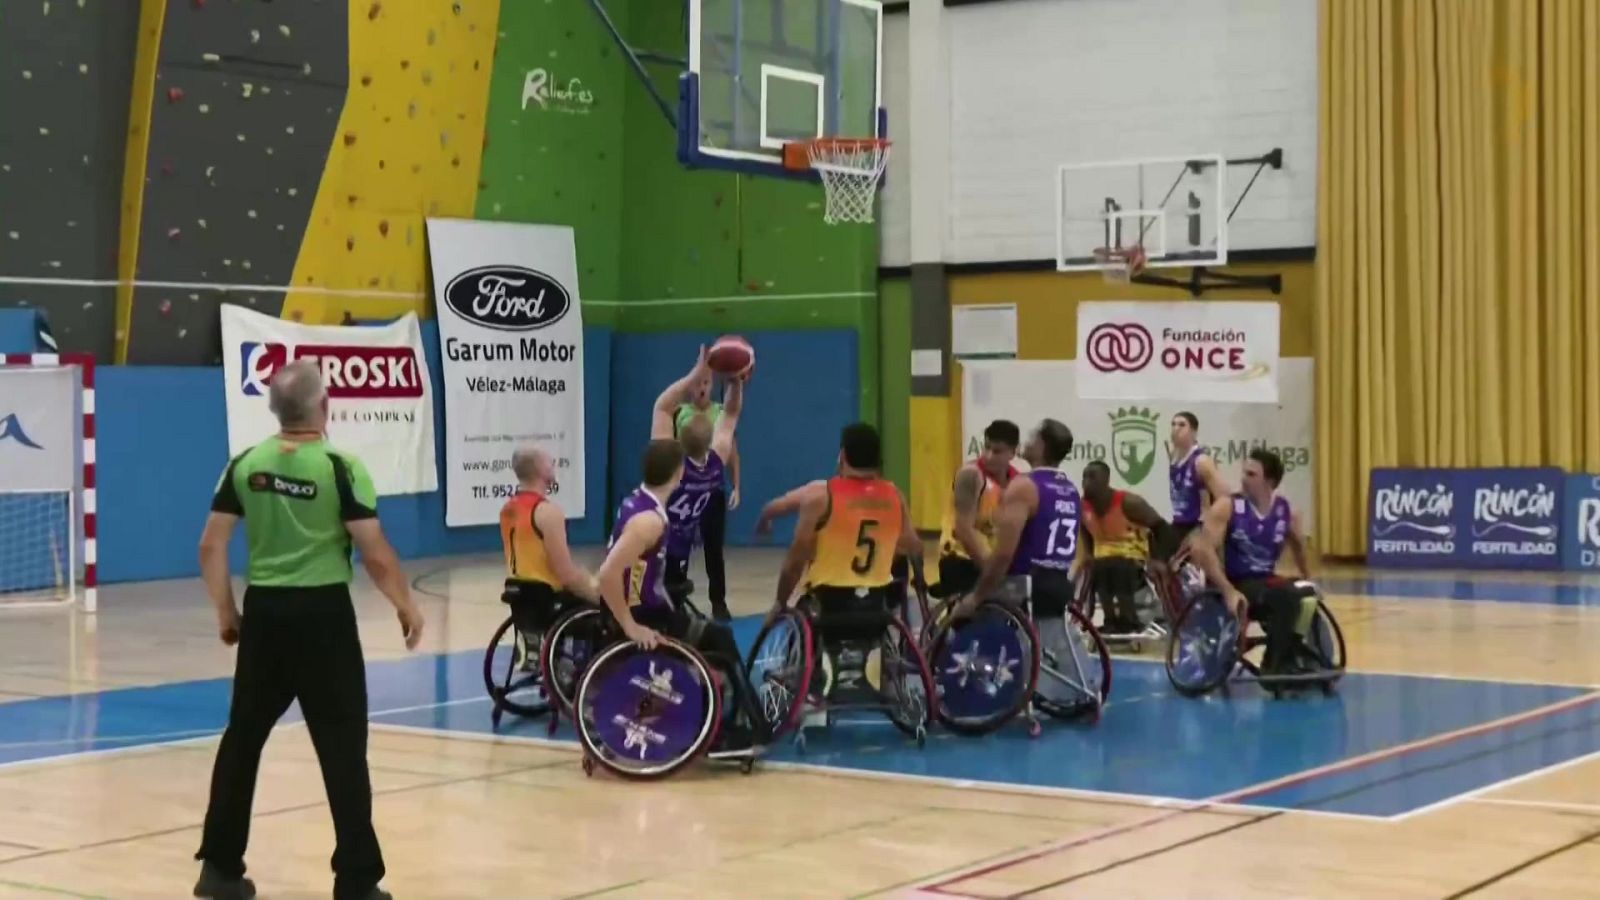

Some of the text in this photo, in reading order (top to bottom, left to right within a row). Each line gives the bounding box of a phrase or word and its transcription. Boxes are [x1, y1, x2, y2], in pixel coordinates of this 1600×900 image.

[472, 275, 545, 319] Ford
[1163, 327, 1245, 342] Fundación
[446, 337, 576, 362] Garum Motor
[1161, 347, 1246, 370] ONCE
[466, 376, 566, 395] Vélez-Málaga
[669, 492, 711, 520] 40
[851, 519, 879, 576] 5
[1046, 518, 1077, 555] 13
[1374, 540, 1455, 553] FERTILIDAD
[1472, 541, 1556, 555] FERTILIDAD
